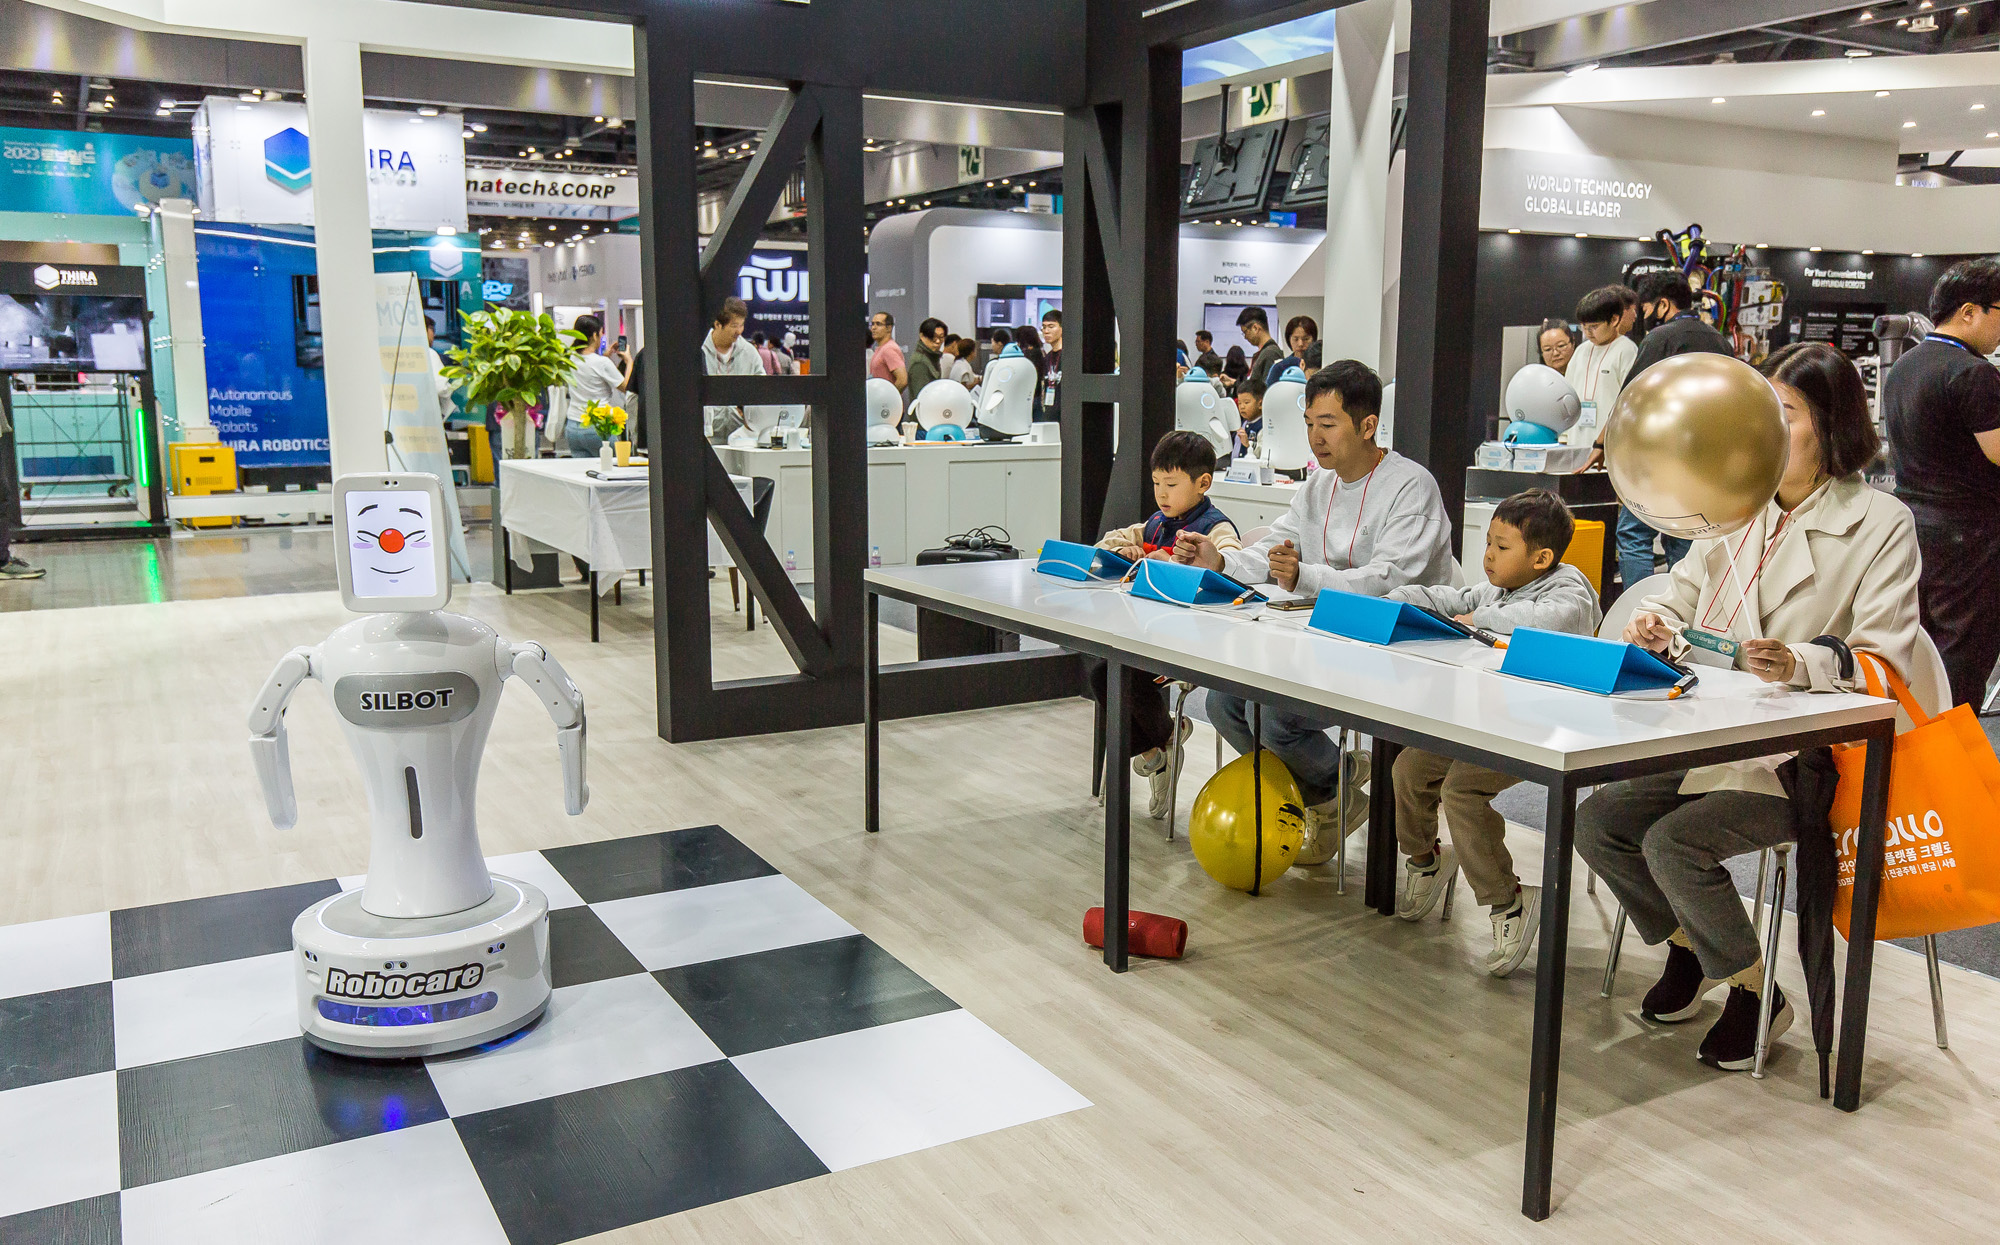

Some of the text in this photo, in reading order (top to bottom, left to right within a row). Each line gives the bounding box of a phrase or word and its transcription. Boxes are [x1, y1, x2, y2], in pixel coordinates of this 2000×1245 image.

[1526, 174, 1652, 200] WORLD TECHNOLOGY
[1524, 196, 1622, 218] GLOBAL LEADER
[60, 270, 98, 281] THIRA
[209, 388, 293, 401] Autonomous
[210, 405, 252, 417] Mobile
[213, 420, 258, 433] Robots
[262, 438, 330, 452] ROBOTICS
[360, 687, 454, 712] SILBOT
[1884, 847, 1918, 867] 플랫폼
[1919, 840, 1953, 859] 크렐로
[325, 961, 485, 1000] Robocare
